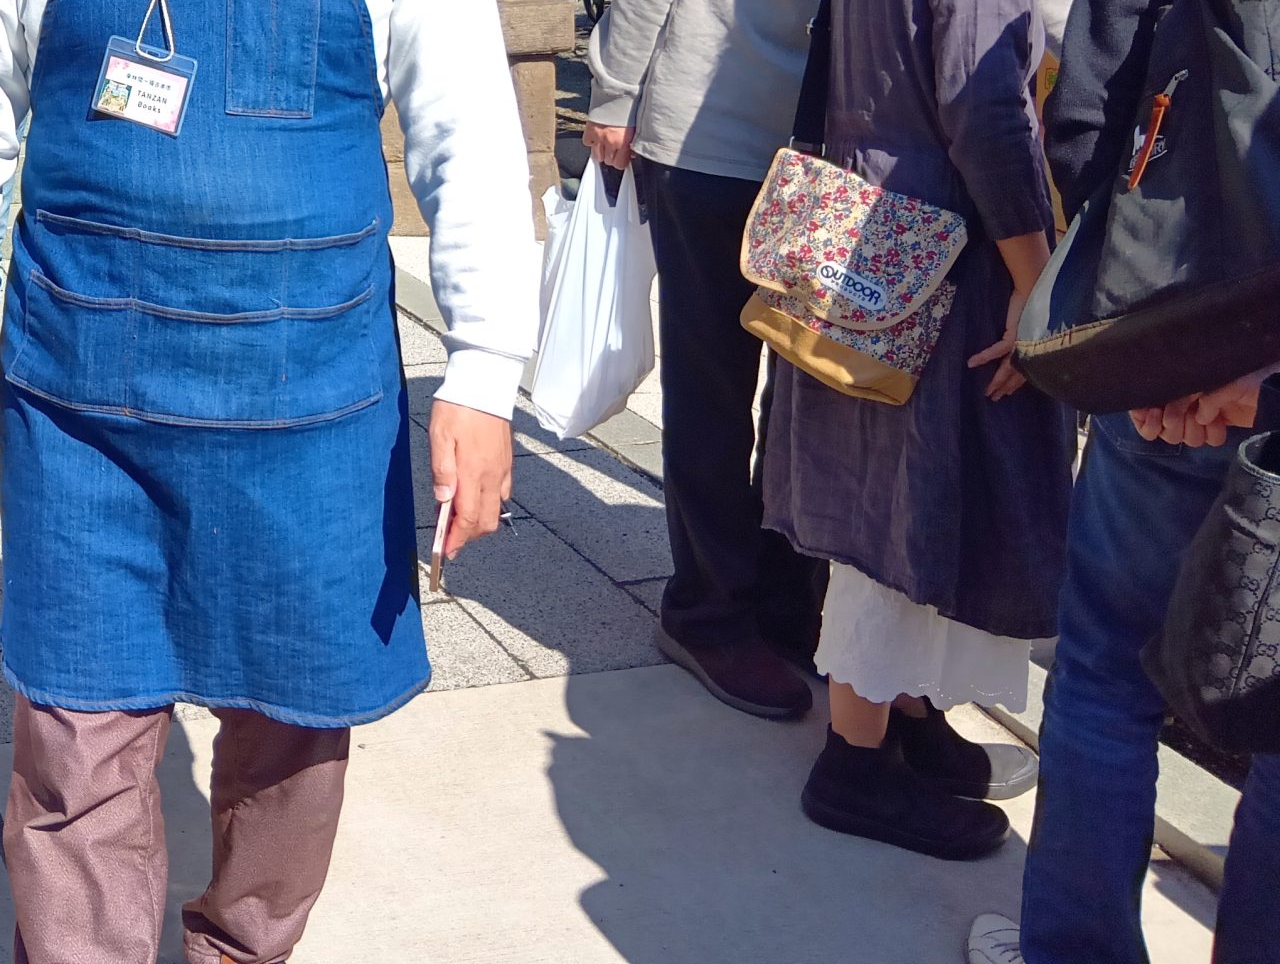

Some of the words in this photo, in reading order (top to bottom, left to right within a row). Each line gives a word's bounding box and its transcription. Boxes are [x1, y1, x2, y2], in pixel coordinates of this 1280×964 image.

[137, 90, 168, 104] TANZAN
[137, 101, 161, 113] Books
[821, 265, 881, 305] OUTDOOR
